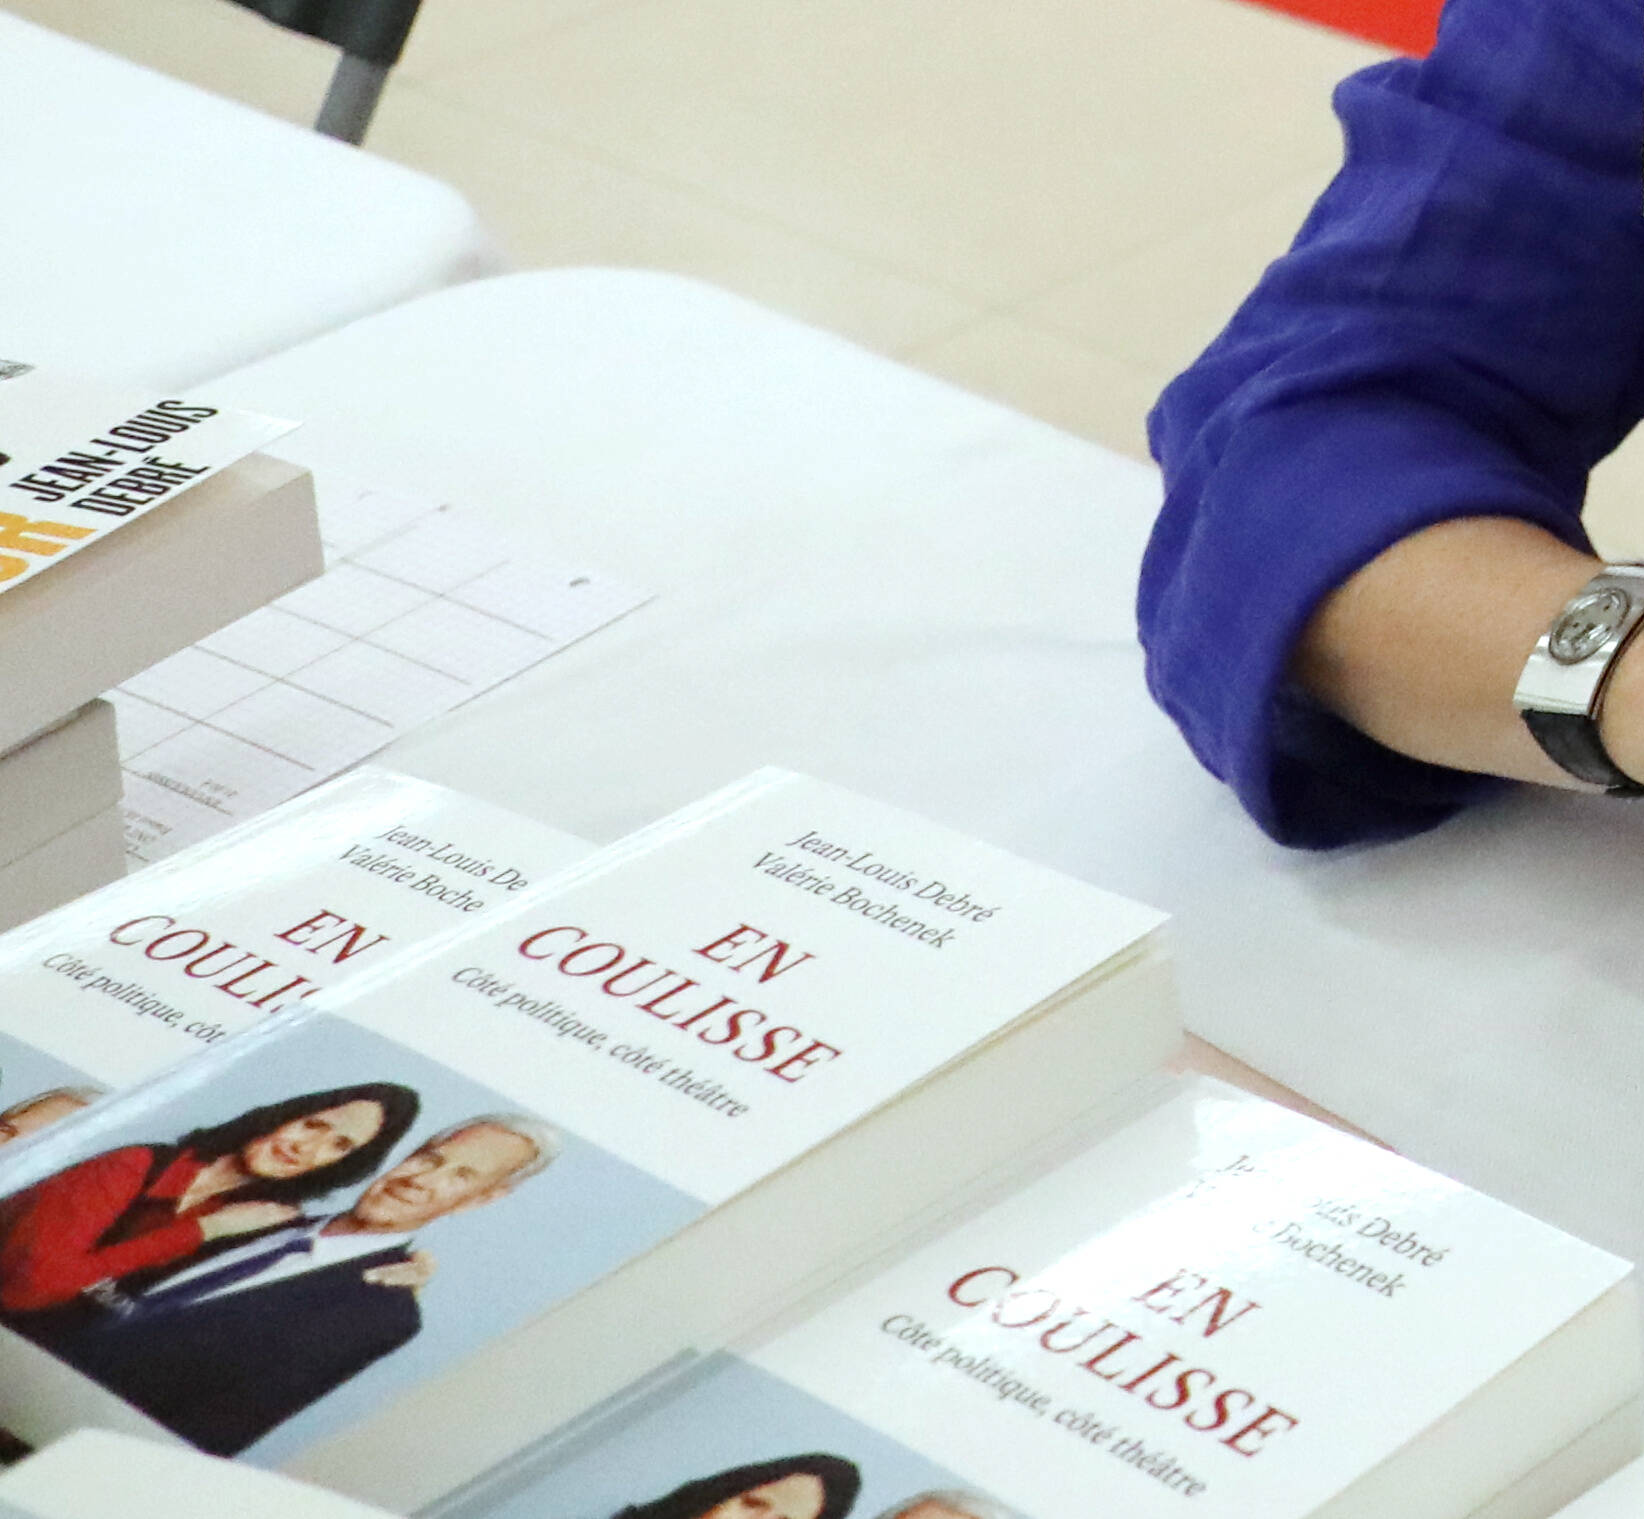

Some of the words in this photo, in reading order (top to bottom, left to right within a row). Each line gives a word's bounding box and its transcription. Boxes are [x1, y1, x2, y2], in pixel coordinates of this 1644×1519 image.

[9, 400, 219, 503] JEAN-LOUIS
[69, 455, 213, 516] DEBRÉ
[337, 845, 416, 883] Valérie
[409, 874, 485, 912] Boche
[375, 825, 495, 877] Jean-Louis
[785, 831, 918, 891] Jean-Louis
[913, 881, 1001, 922] Debré
[273, 909, 391, 964] EN
[753, 851, 835, 895] Valérie
[830, 886, 955, 948] Bochenek
[42, 953, 97, 982] Côté
[80, 970, 180, 1028] politique,
[184, 1020, 226, 1043] côt
[691, 923, 816, 984] EN
[452, 966, 512, 998] Côté
[494, 988, 608, 1051] politique,
[608, 1041, 667, 1075] côté
[658, 1065, 750, 1118] théâtre
[517, 925, 843, 1083] COULISSE
[1357, 1217, 1450, 1267] Debré
[1131, 1268, 1263, 1338] EN
[881, 1314, 944, 1352] Côté
[930, 1338, 1053, 1416] politique,
[1053, 1405, 1116, 1444] côté
[1109, 1435, 1208, 1499] théâtre
[947, 1266, 1300, 1457] COULISSE
